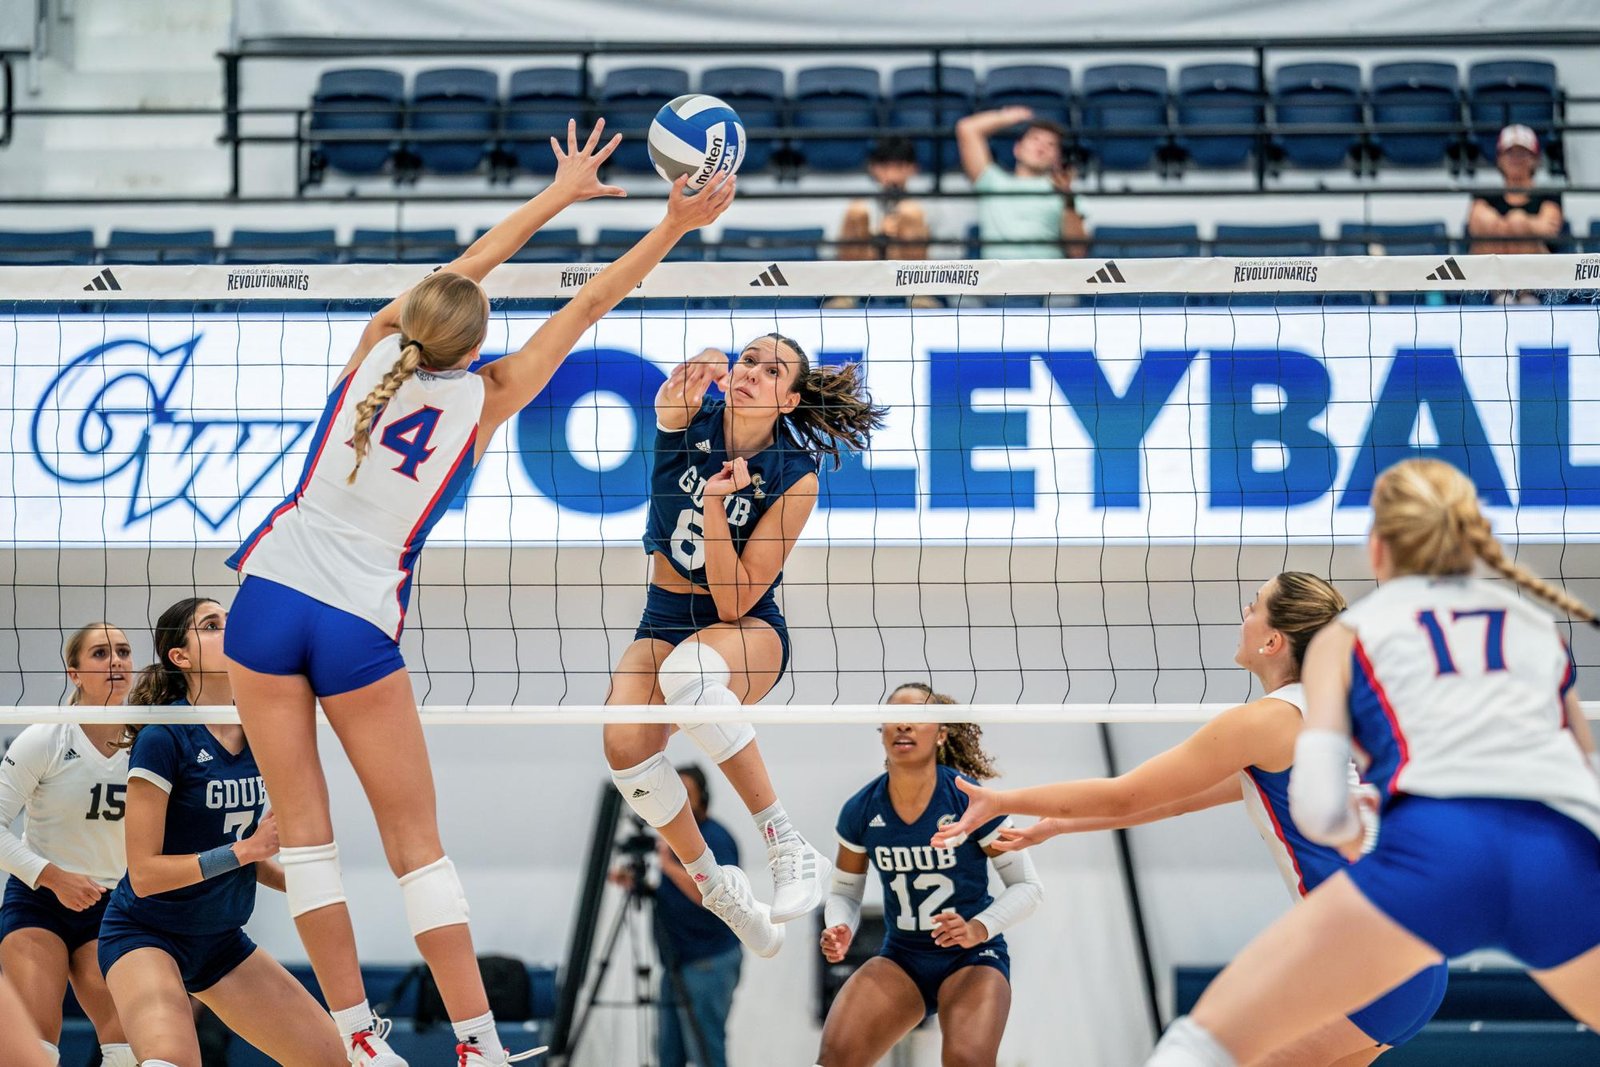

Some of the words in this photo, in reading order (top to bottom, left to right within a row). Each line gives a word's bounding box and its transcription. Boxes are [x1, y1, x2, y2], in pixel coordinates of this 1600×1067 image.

[695, 137, 723, 185] molten
[722, 145, 738, 173] CAA
[227, 274, 309, 291] REVOLUTIONARIES
[896, 269, 979, 287] REVOLUTIONARIES
[1233, 266, 1318, 284] REVOLUTIONARIES
[1575, 263, 1600, 281] REVO
[670, 508, 705, 571] 6
[1415, 607, 1507, 678] 17
[85, 783, 128, 821] 15
[223, 810, 255, 841] 7
[874, 846, 957, 872] GDUB
[889, 872, 957, 932] 12
